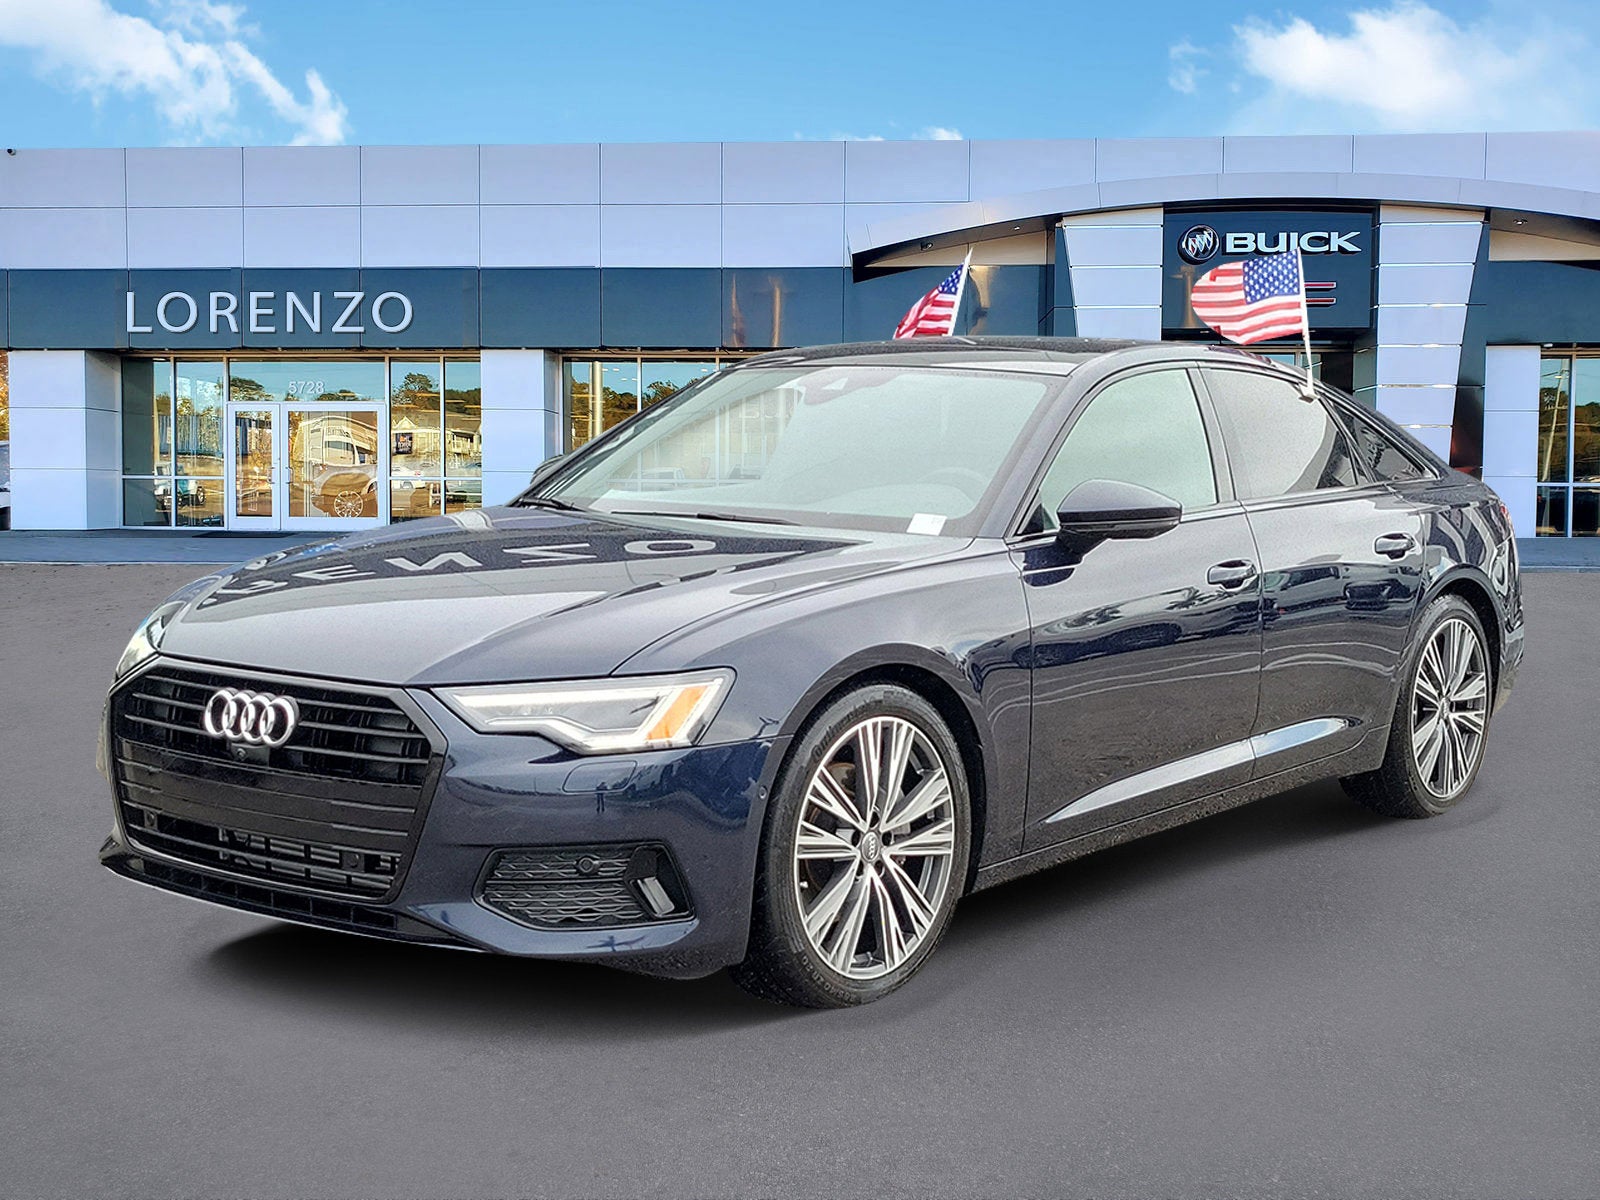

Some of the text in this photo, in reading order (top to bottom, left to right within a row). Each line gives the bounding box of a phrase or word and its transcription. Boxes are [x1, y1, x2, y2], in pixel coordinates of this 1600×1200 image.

[1225, 231, 1362, 254] BUICK
[126, 290, 413, 333] LORENZO
[288, 380, 325, 394] 5728
